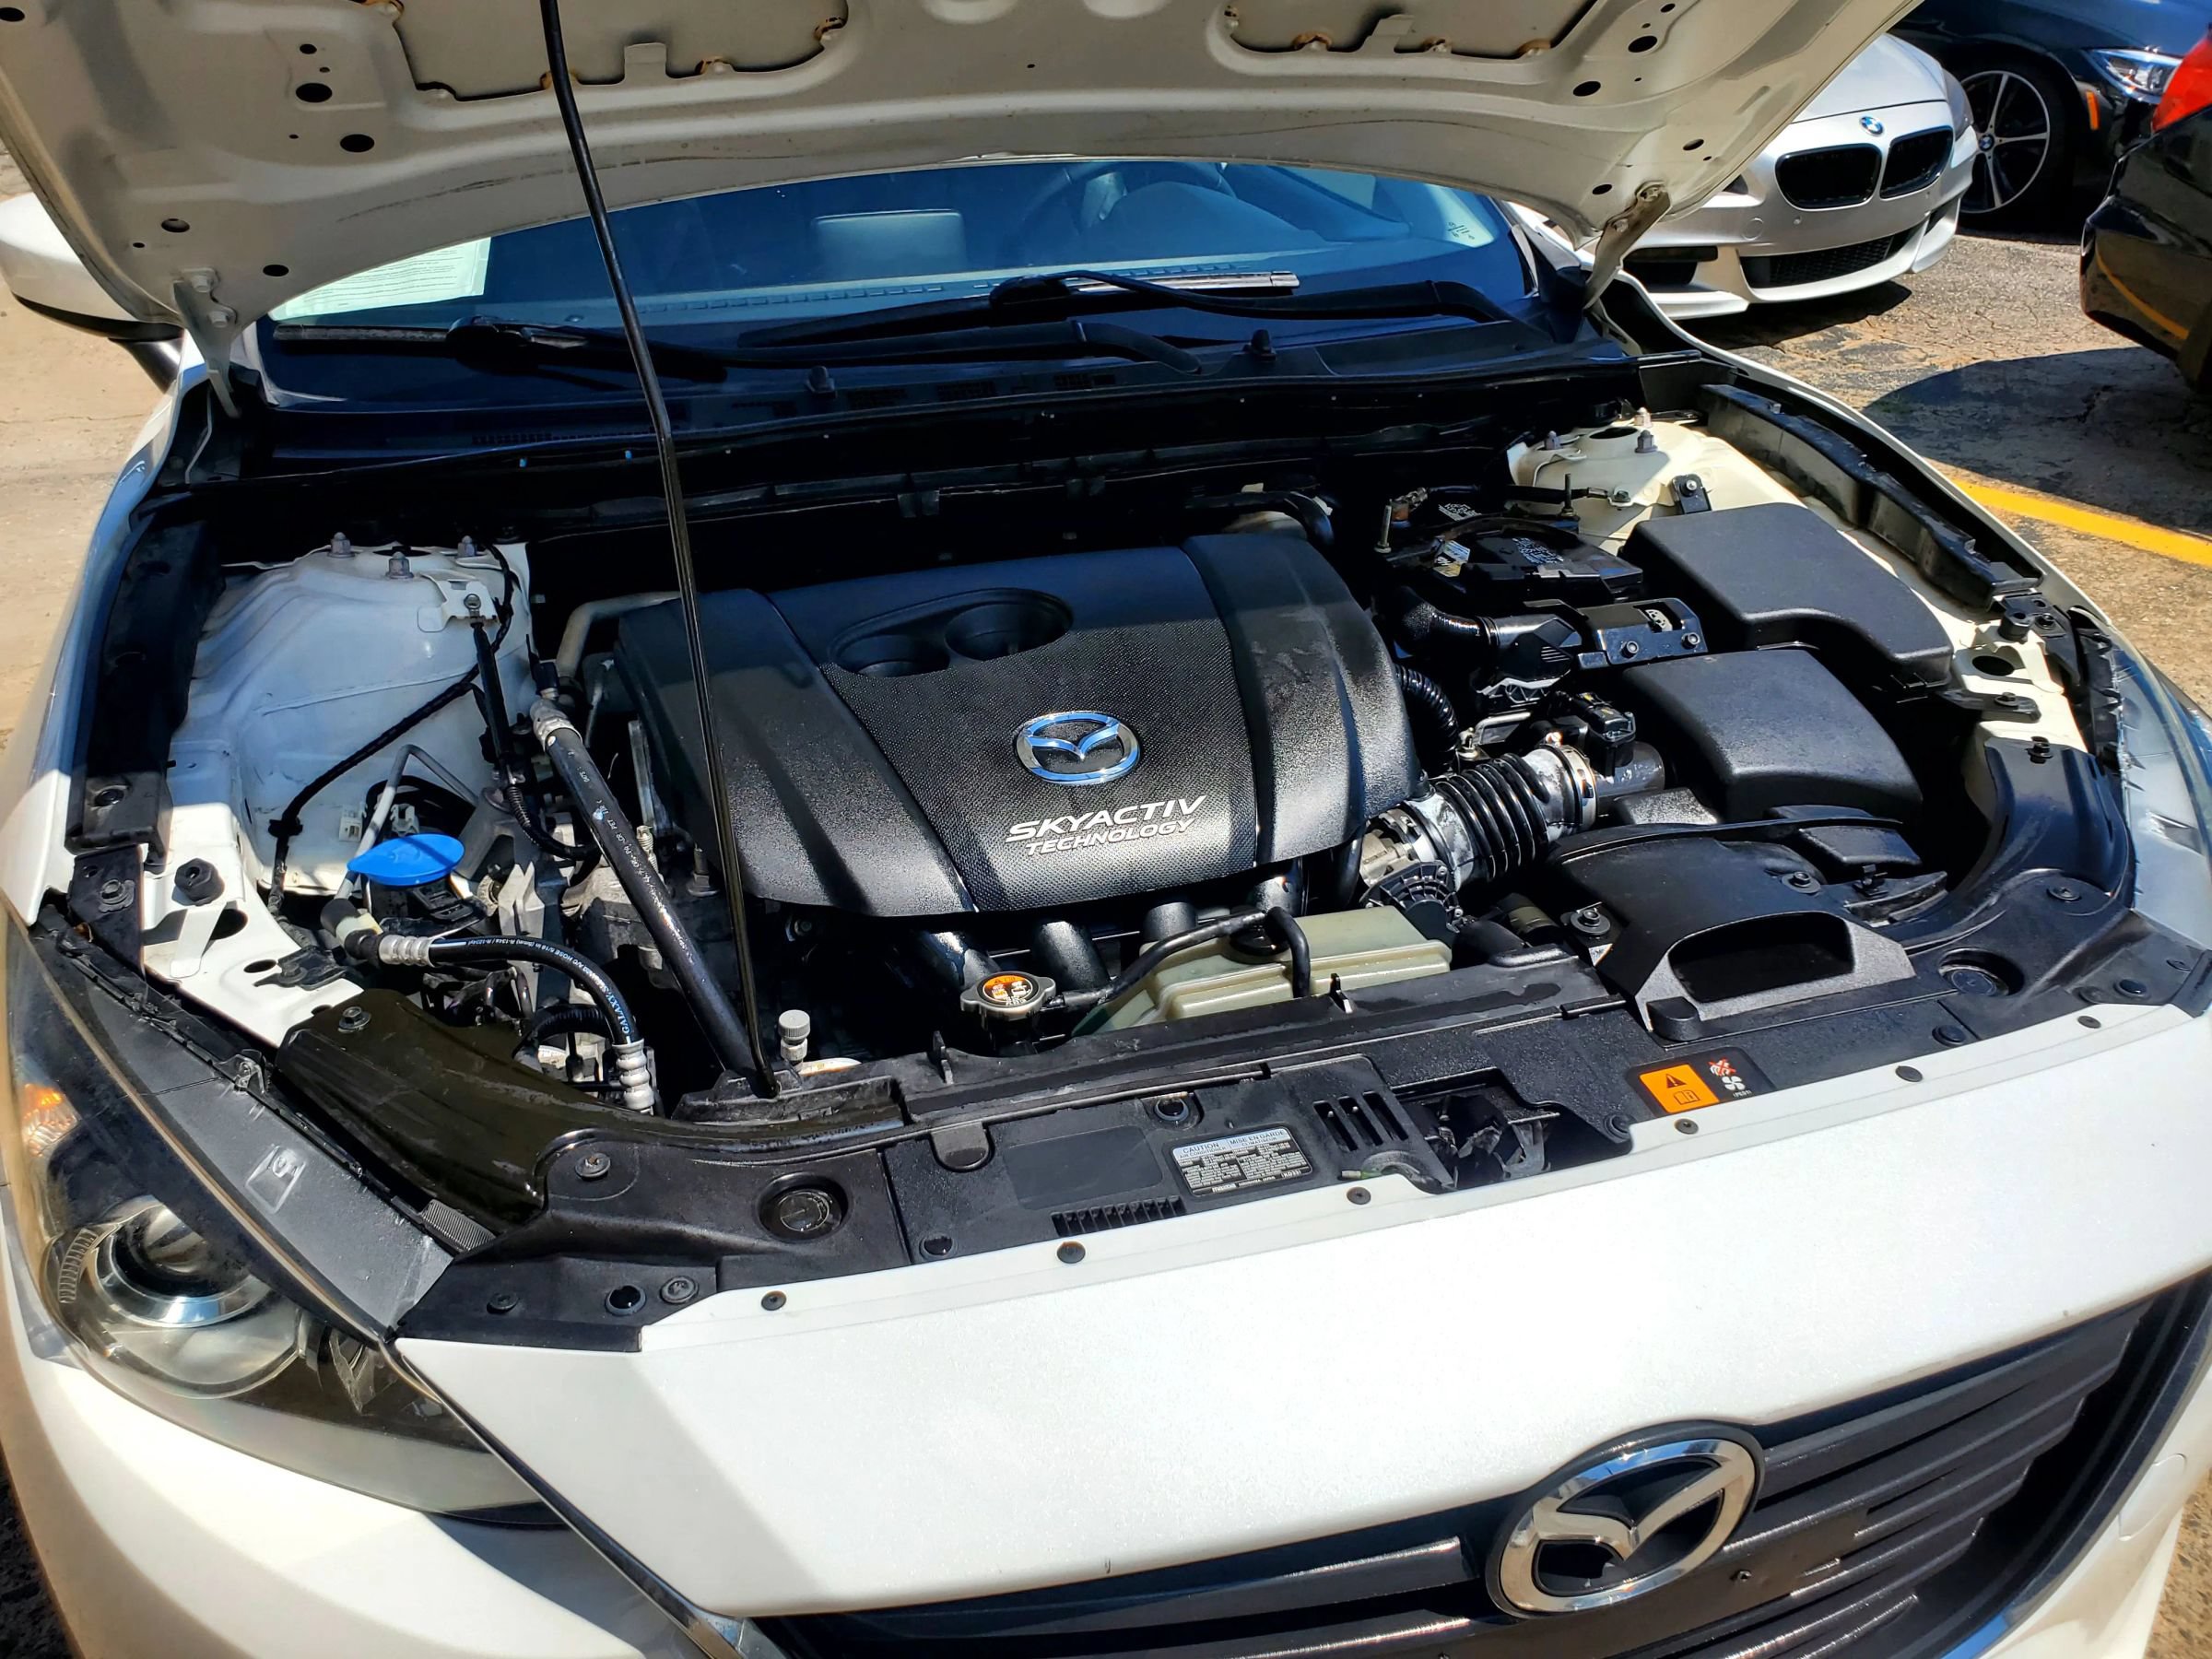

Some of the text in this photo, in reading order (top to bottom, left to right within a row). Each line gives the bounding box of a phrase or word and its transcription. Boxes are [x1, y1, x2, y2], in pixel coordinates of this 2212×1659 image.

[1006, 795, 1207, 842] SKYACTIV
[1025, 818, 1195, 855] TECHNOLOGY
[554, 948, 573, 961] HOSE
[606, 992, 631, 1035] GALAXY
[1182, 1142, 1218, 1153] CAUTION
